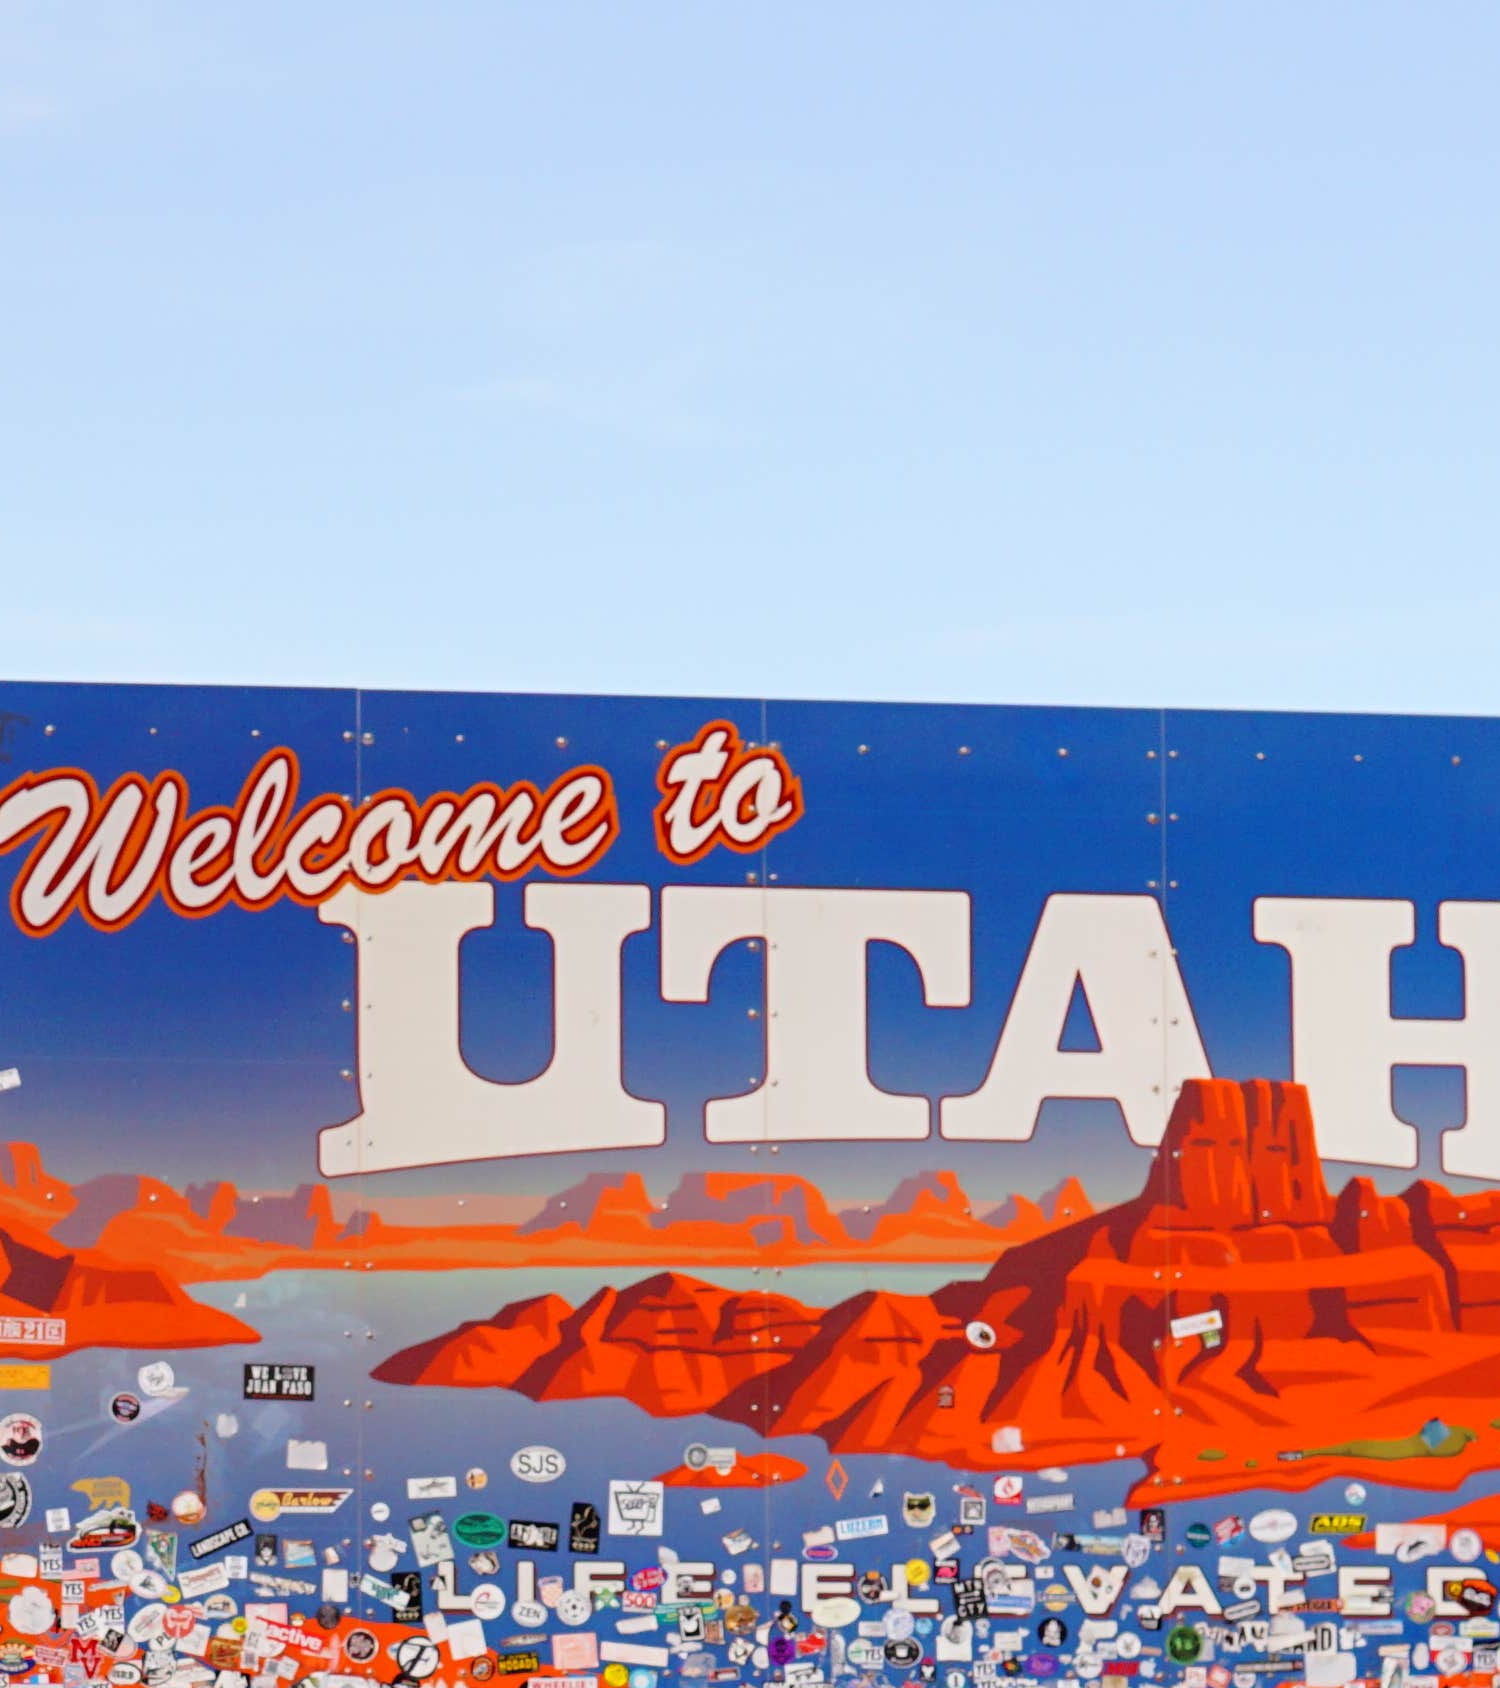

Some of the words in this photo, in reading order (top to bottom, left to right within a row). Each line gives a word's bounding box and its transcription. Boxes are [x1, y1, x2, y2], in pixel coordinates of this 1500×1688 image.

[657, 721, 800, 864] to
[517, 1453, 559, 1475] SJS
[64, 1583, 82, 1597] YES
[437, 1560, 717, 1613] LIFE
[104, 1608, 123, 1621] YES
[518, 1607, 541, 1619] ZEN
